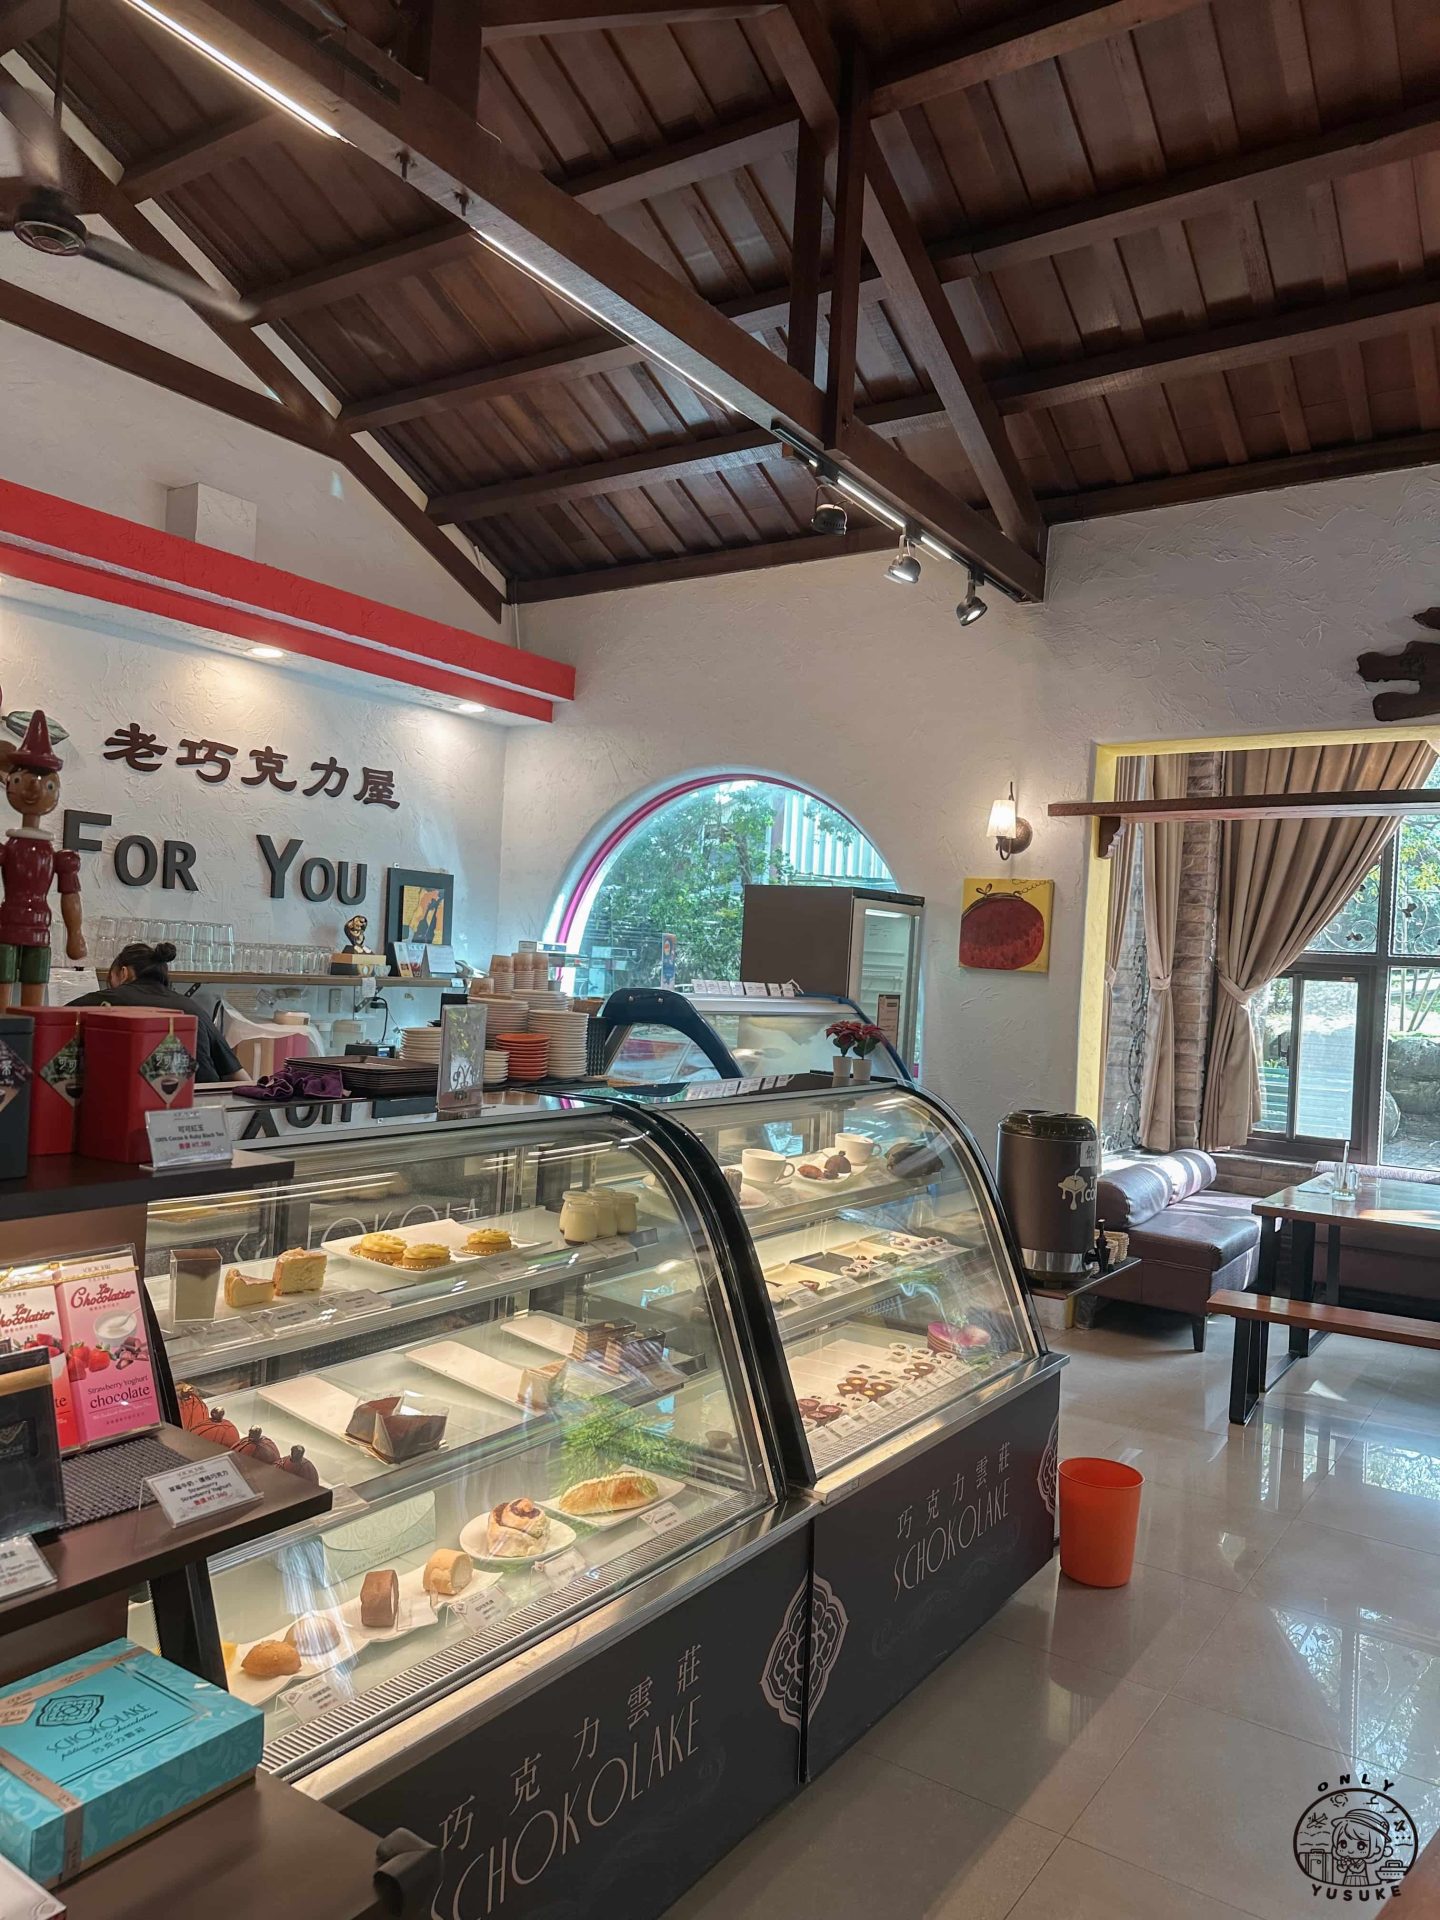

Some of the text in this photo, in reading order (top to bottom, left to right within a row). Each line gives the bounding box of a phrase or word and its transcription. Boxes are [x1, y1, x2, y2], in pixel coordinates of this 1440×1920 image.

[103, 722, 401, 810] 老巧克力屋
[70, 1286, 136, 1309] Chocolatier
[87, 1374, 149, 1395] Strawberry Yoghurt
[90, 1385, 151, 1410] chocolate
[896, 1442, 1012, 1539] 巧克力雲莊
[893, 1479, 1012, 1602] SCHOKOLAKE
[438, 1644, 704, 1851] 巧克力雲莊
